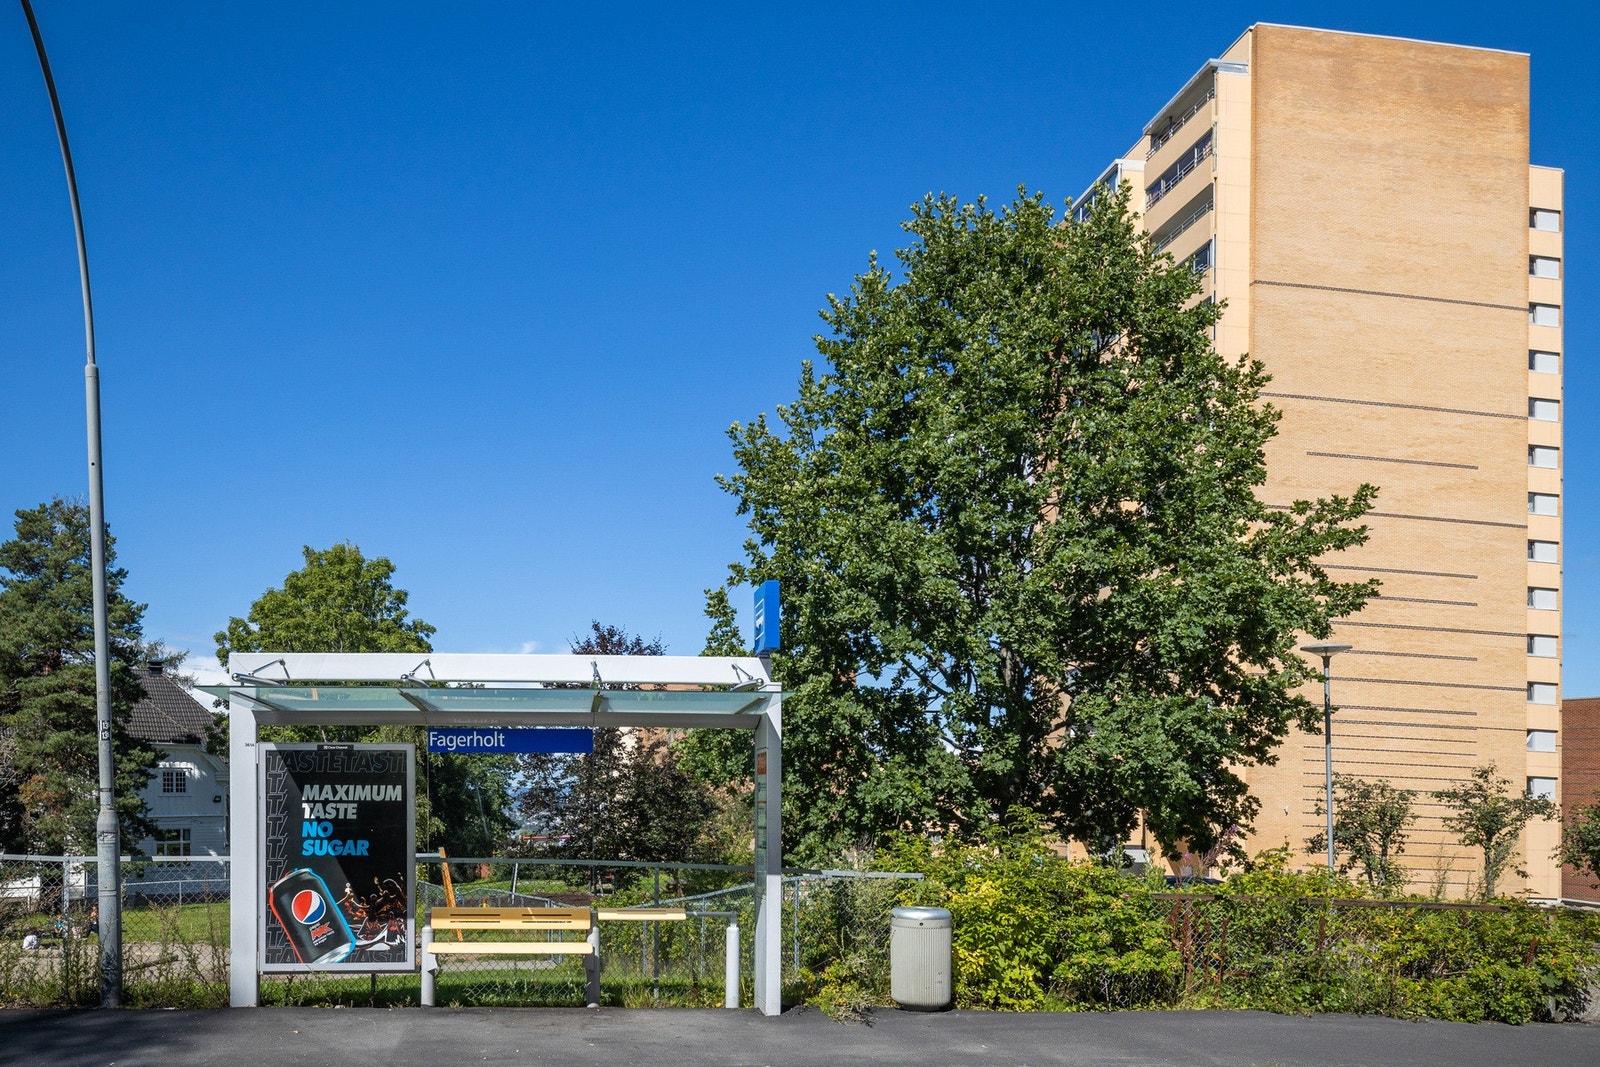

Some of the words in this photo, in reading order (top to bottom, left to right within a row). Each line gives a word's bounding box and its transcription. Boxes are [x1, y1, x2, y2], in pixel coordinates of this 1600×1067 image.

[429, 731, 505, 750] Fagerholt
[302, 784, 402, 801] MAXIMUM
[302, 803, 358, 819] TASTE
[302, 821, 333, 838] NO
[302, 840, 369, 857] SUGAR
